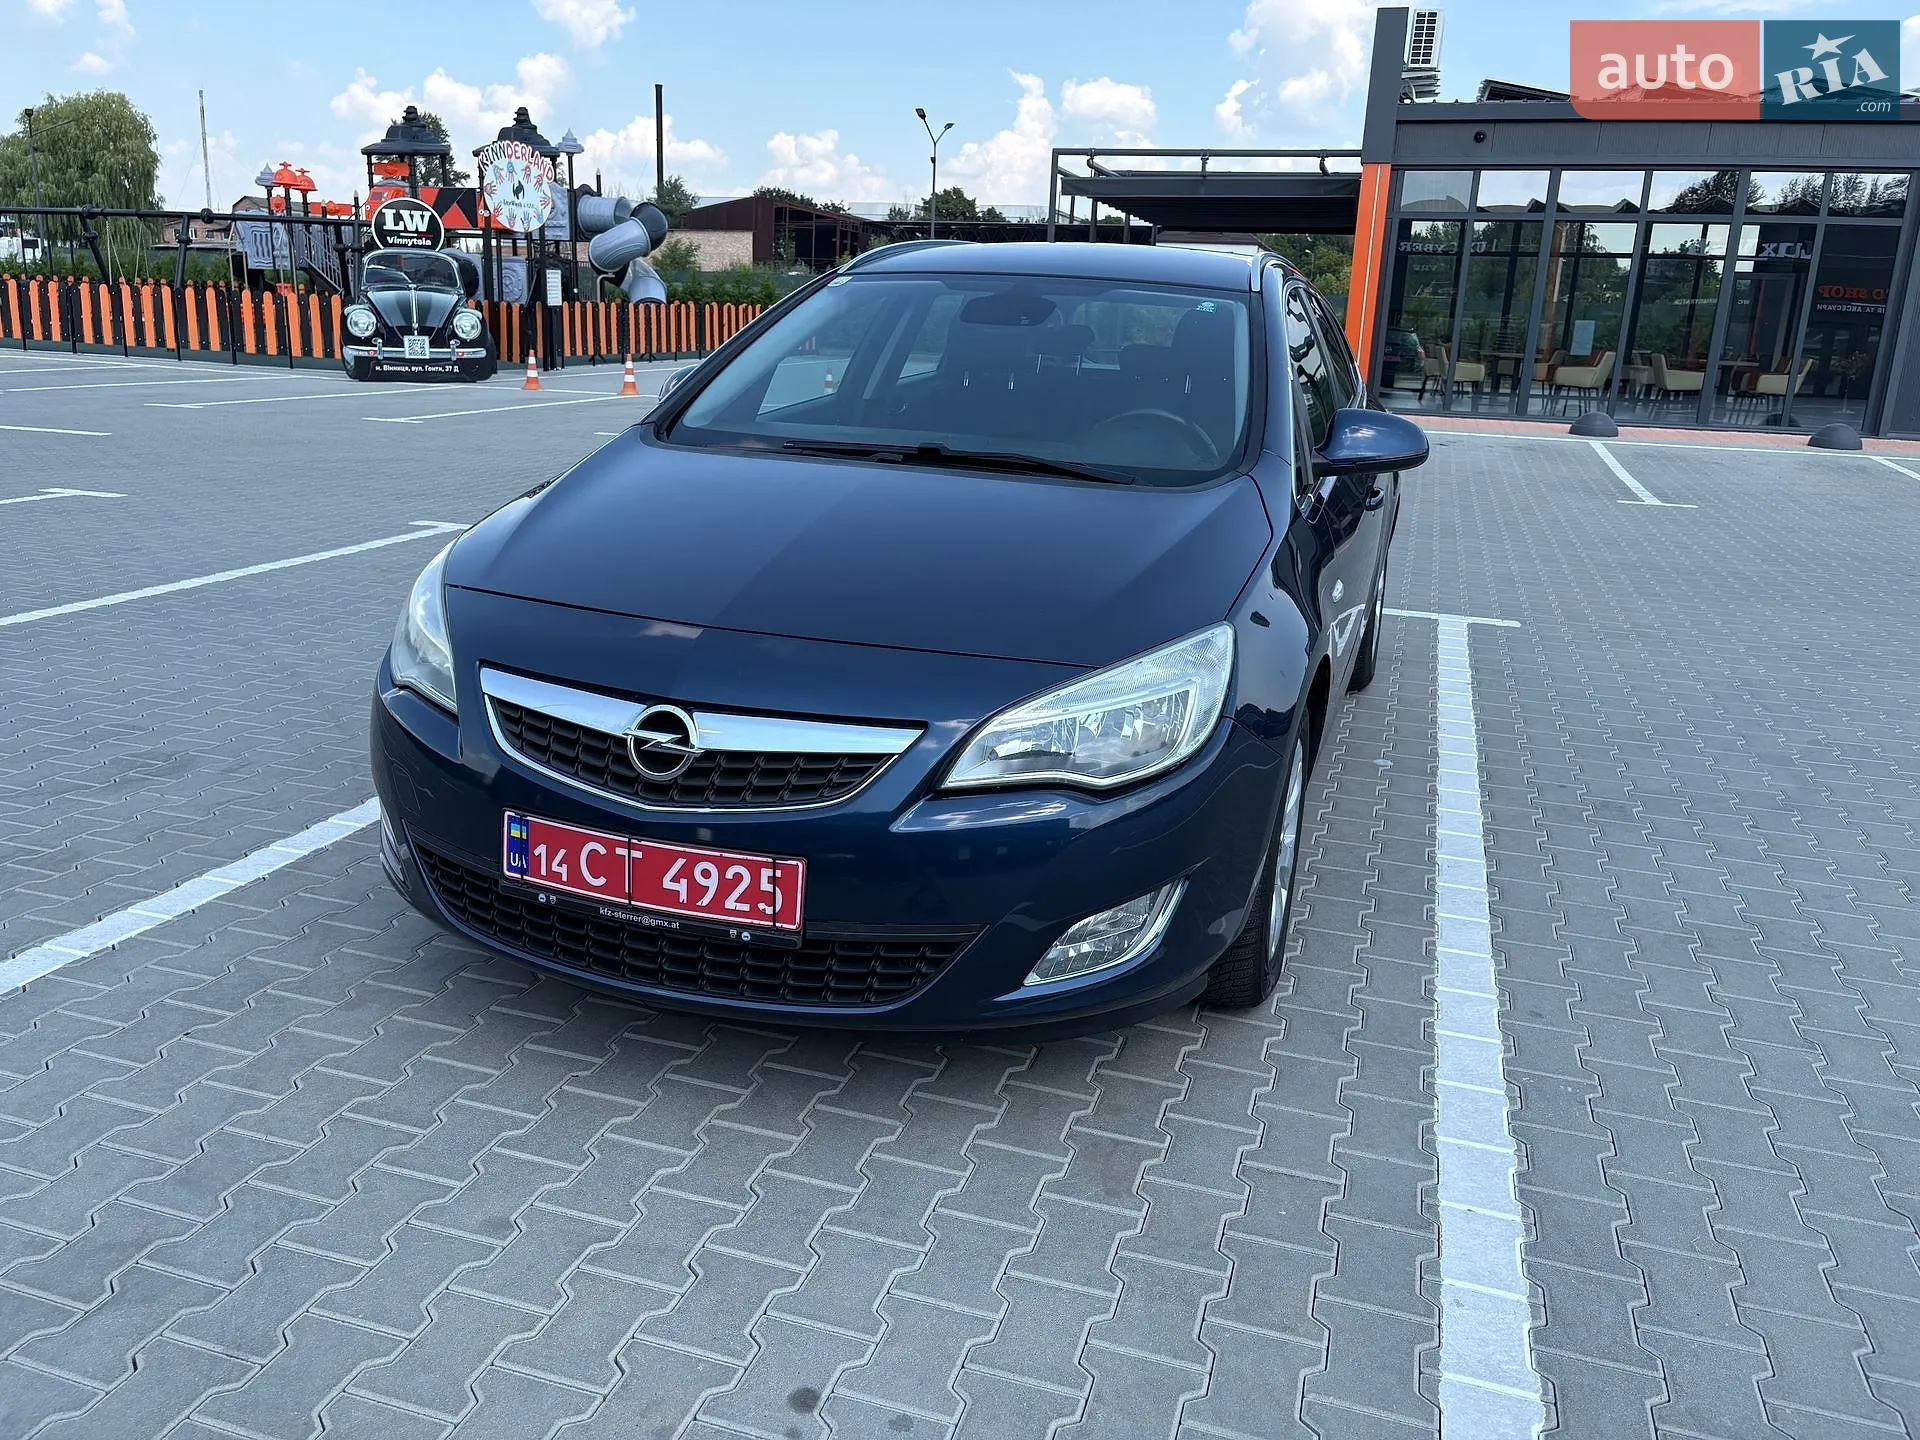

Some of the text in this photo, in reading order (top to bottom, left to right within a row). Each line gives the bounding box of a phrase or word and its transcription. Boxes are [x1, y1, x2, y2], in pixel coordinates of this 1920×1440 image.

[479, 140, 555, 183] KINNDERLAND
[381, 208, 432, 232] LW
[386, 235, 432, 247] Vinnytsia
[383, 364, 411, 372] Вінниця,
[509, 851, 527, 869] UA
[533, 841, 783, 915] 14 CT 4925
[599, 906, 680, 930] kfz-sterrer@gmx.at
